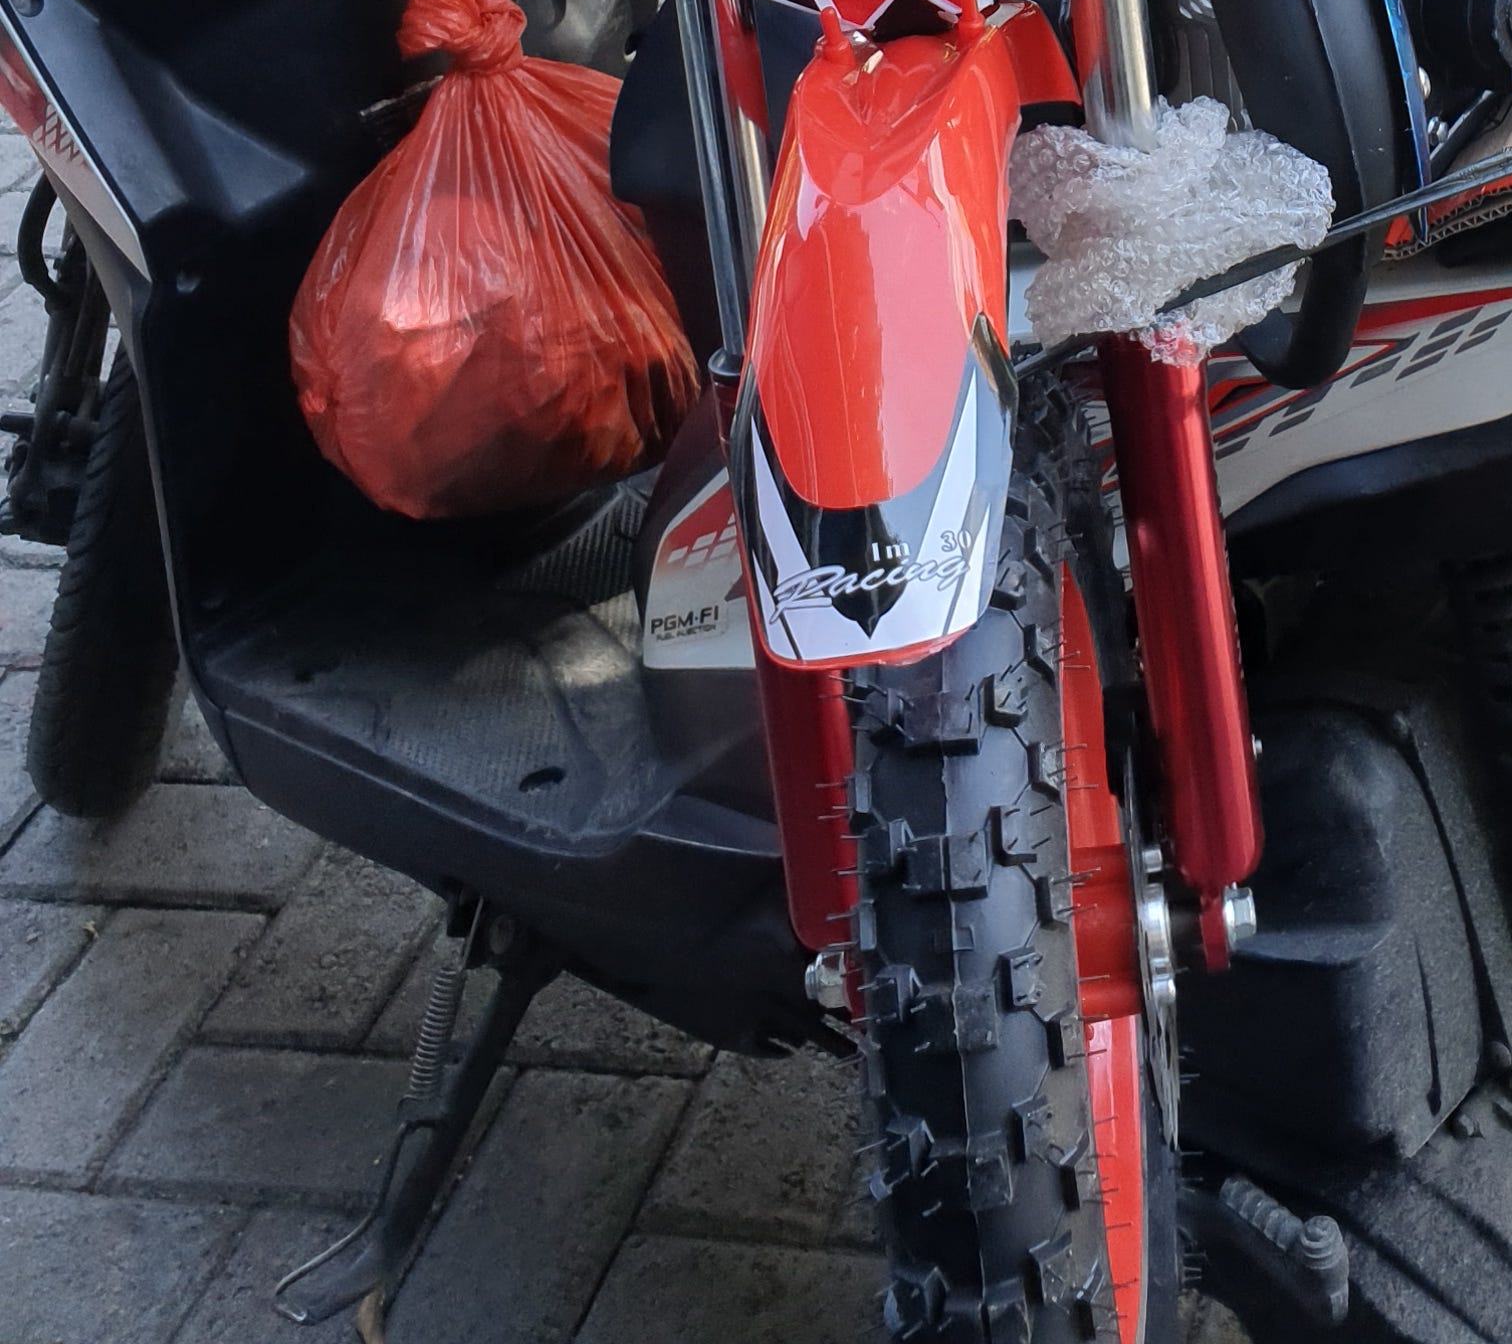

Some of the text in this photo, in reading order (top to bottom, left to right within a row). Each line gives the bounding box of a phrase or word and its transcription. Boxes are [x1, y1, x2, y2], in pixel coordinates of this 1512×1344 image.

[871, 530, 972, 562] Im 30
[769, 554, 971, 625] Racing
